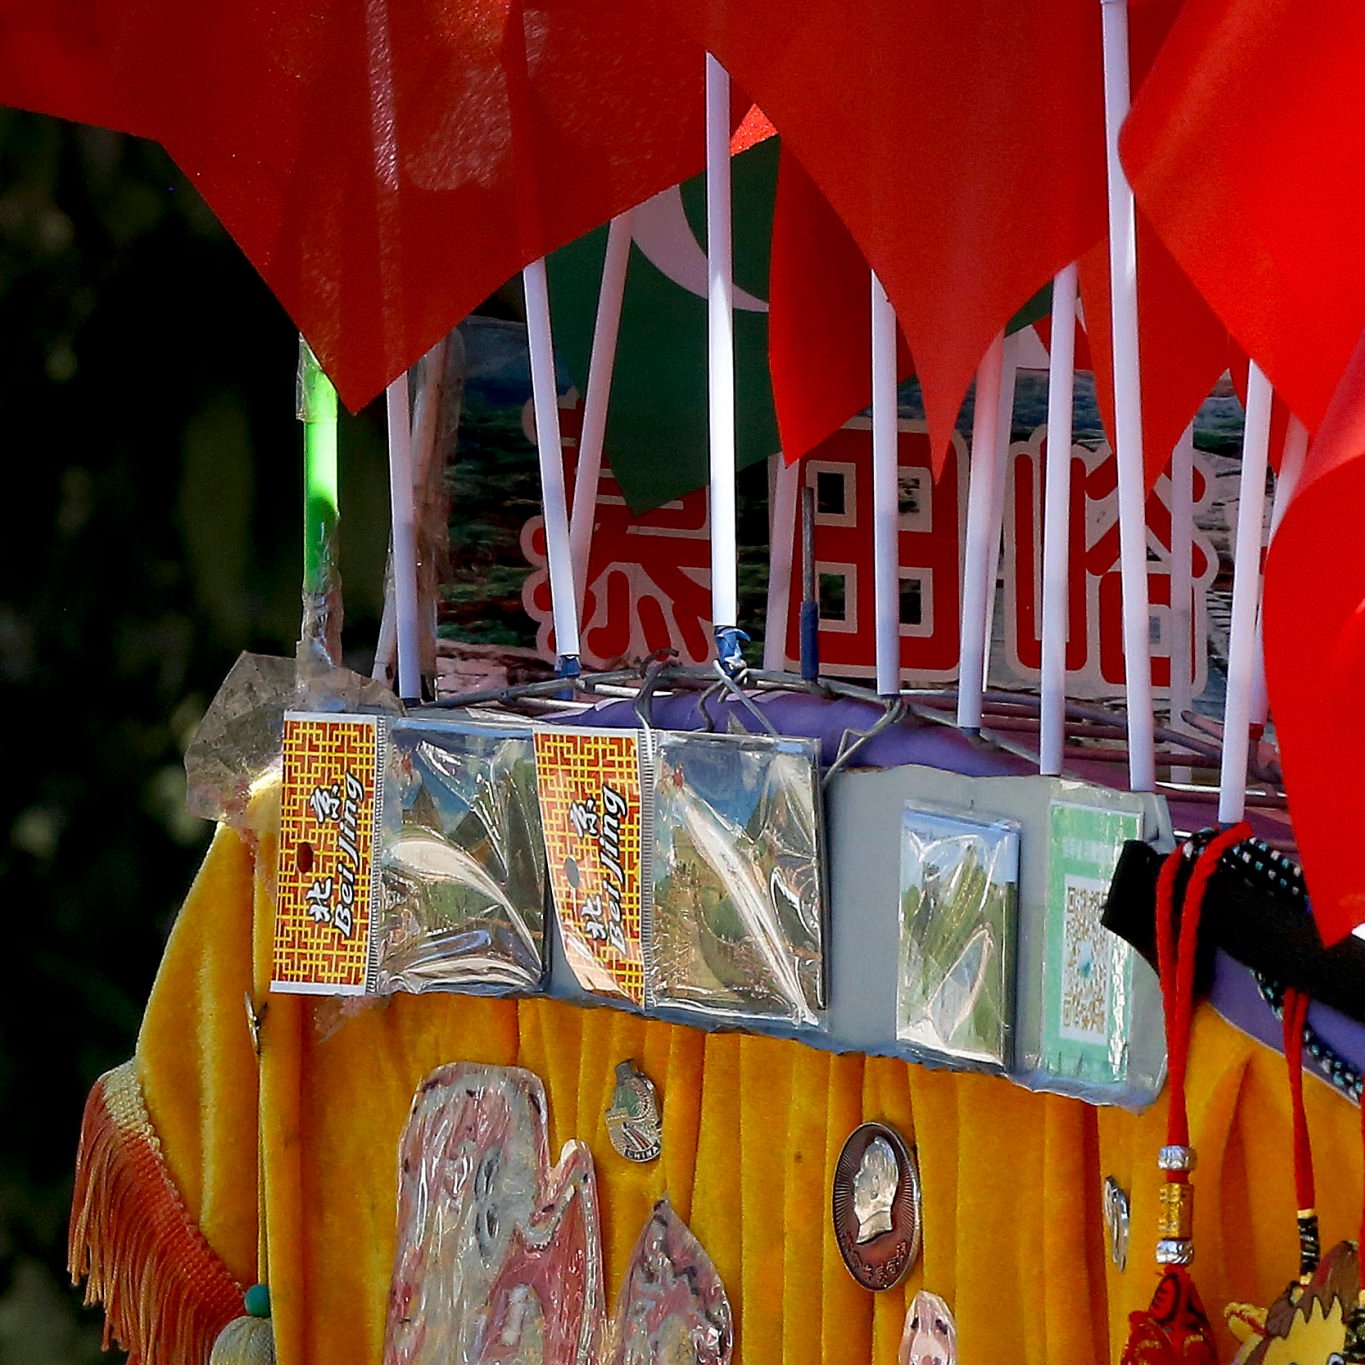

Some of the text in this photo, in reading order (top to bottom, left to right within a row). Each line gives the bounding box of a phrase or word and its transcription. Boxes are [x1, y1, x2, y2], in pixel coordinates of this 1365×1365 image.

[335, 771, 365, 938] Bei Jing
[600, 784, 628, 885] Jing
[625, 1143, 661, 1160] CHINA
